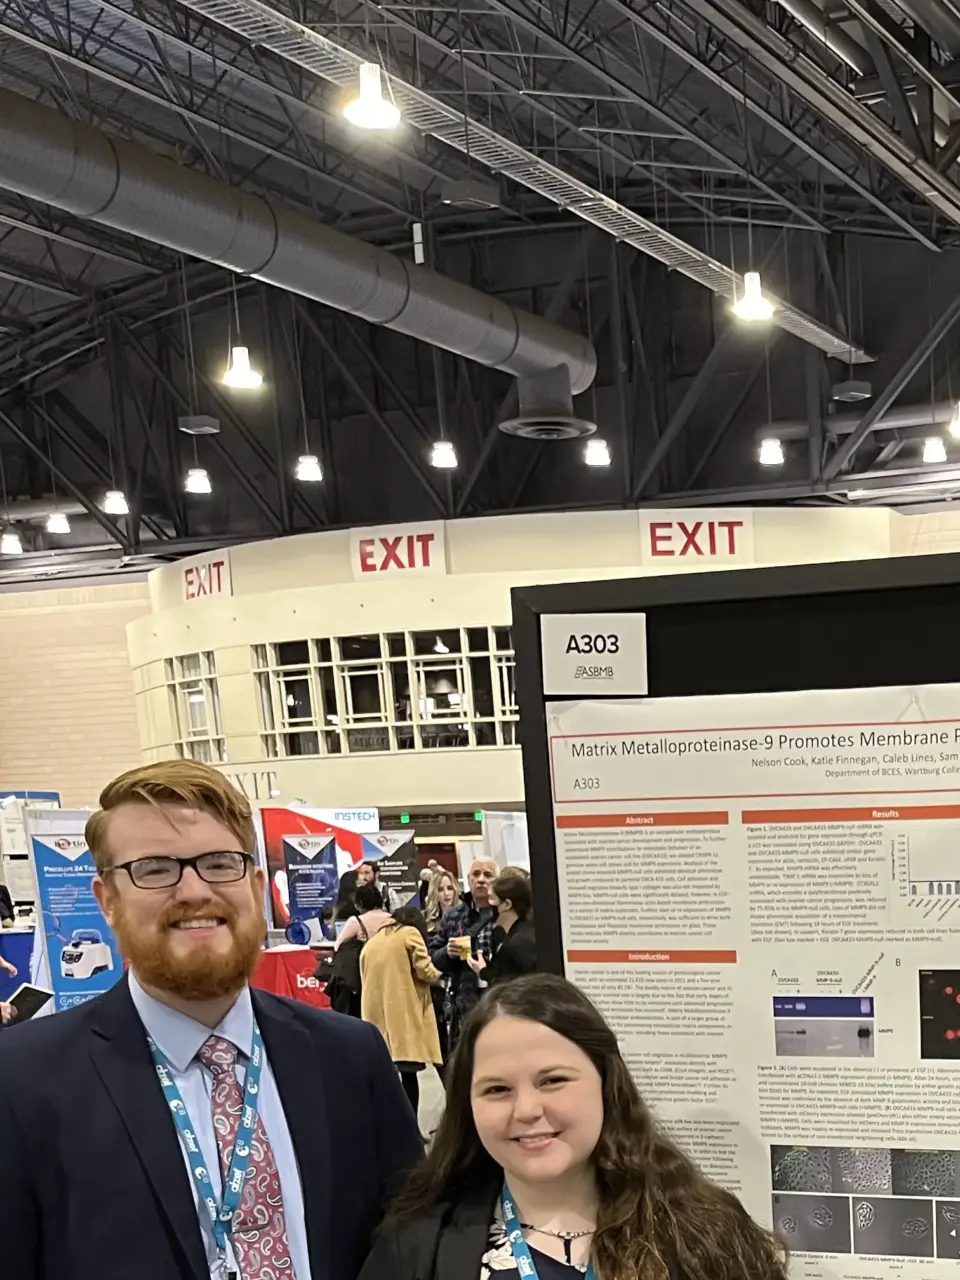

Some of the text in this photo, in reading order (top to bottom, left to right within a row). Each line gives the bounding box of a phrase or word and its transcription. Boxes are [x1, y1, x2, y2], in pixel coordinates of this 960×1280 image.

[649, 521, 744, 556] EXIT
[359, 533, 434, 573] EXIT
[184, 561, 225, 600] EXIT
[566, 634, 620, 655] A303
[581, 666, 614, 677] ASBMB
[571, 741, 617, 757] Matrix
[621, 734, 773, 756] Metalloproteinase-9
[779, 734, 854, 749] Promotes
[860, 729, 948, 746] Membrane
[751, 758, 781, 767] Nelson
[783, 756, 808, 766] Cook,
[811, 756, 833, 765] Katie
[835, 755, 879, 765] Finnegan,
[882, 753, 908, 763] Caleb
[911, 754, 936, 763] Lines,
[939, 751, 958, 761] Sam
[825, 769, 870, 778] Department
[871, 767, 880, 776] of
[881, 767, 902, 776] BCES,
[904, 767, 940, 775] Wartburg
[227, 771, 277, 800] XIT
[573, 777, 601, 790] A303
[334, 812, 376, 821] INSTECH
[625, 815, 654, 825] Abstract
[871, 809, 899, 819] Results
[628, 952, 670, 962] Introduction
